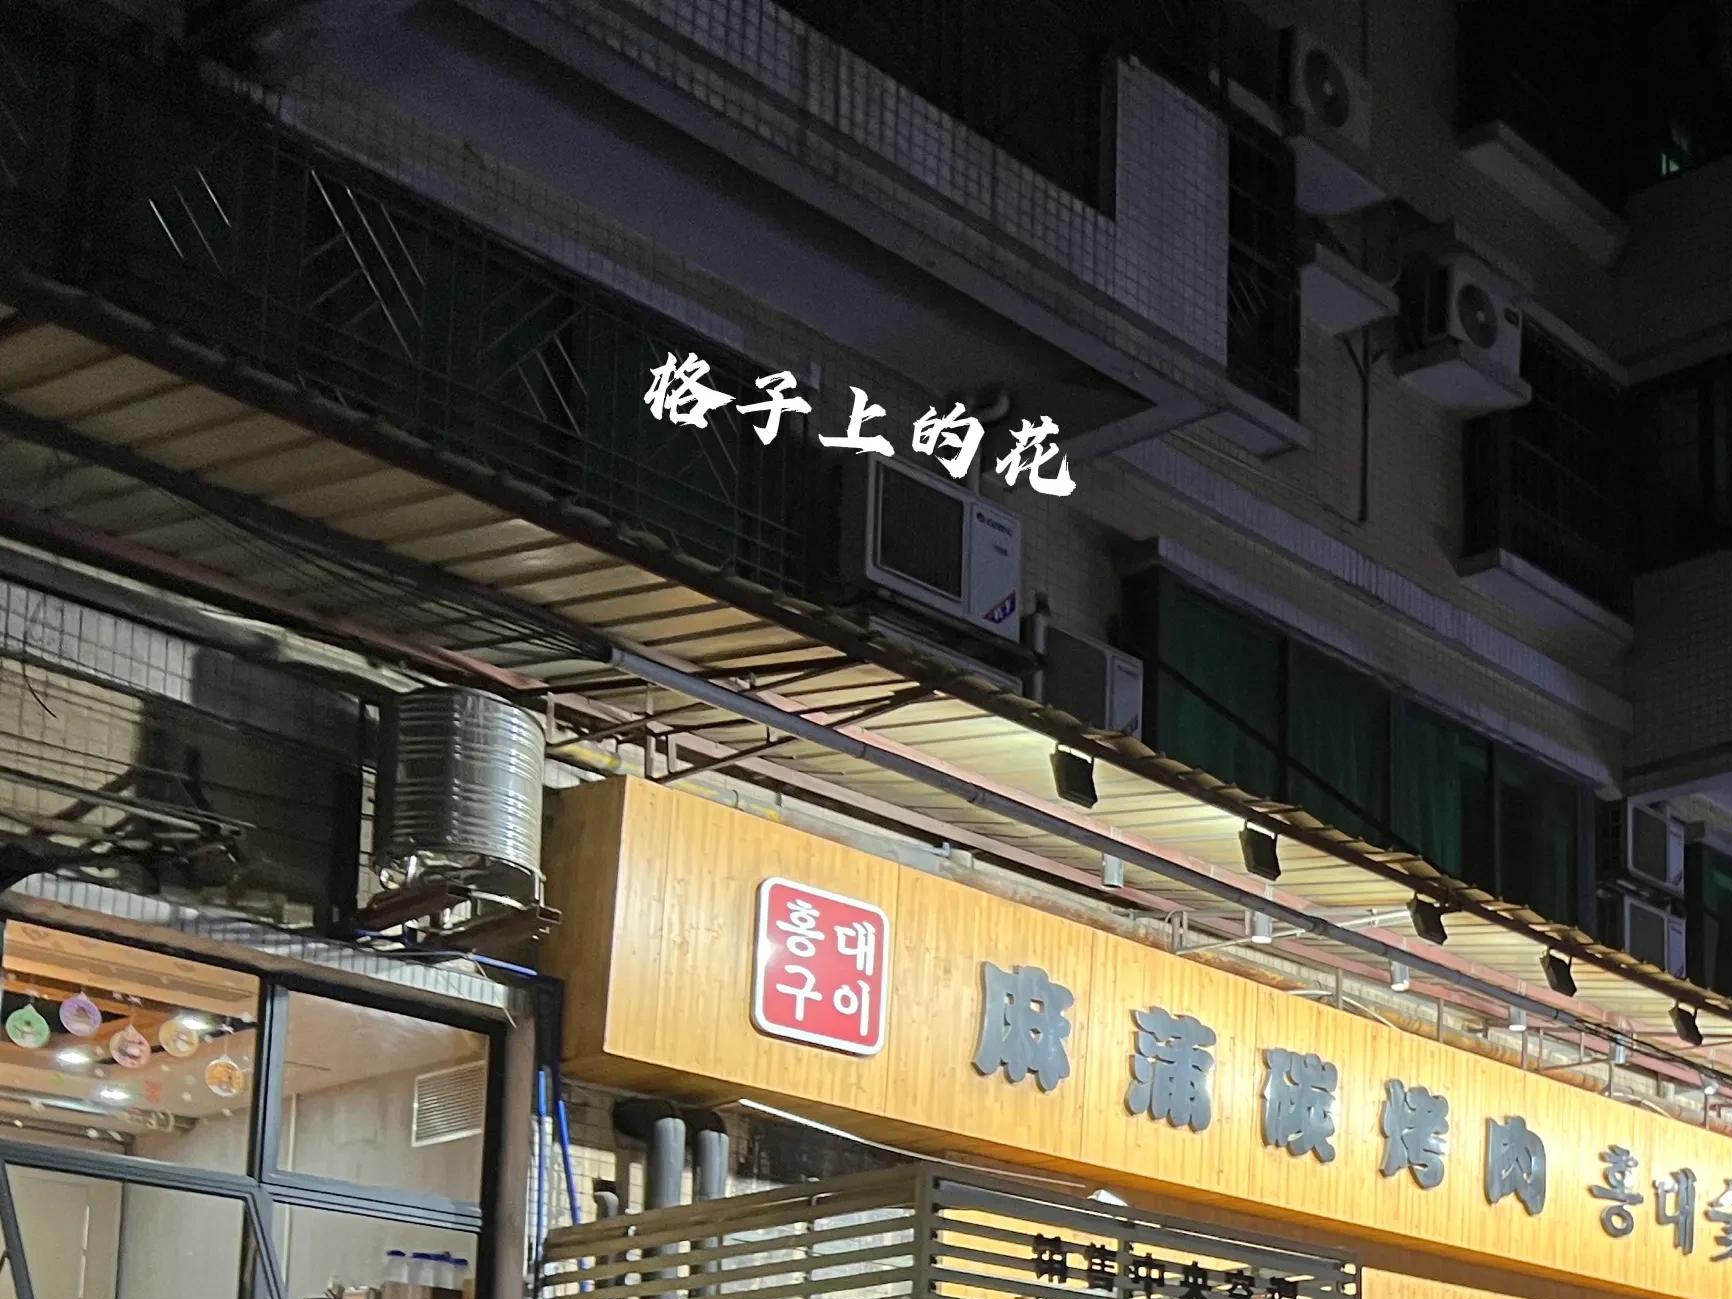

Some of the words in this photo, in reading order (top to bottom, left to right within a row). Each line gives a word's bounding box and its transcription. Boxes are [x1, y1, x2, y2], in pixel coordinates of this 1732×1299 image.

[775, 899, 876, 977] 홍대
[775, 964, 872, 1037] 구이
[972, 963, 1547, 1217] 麻蒲碳烤肉
